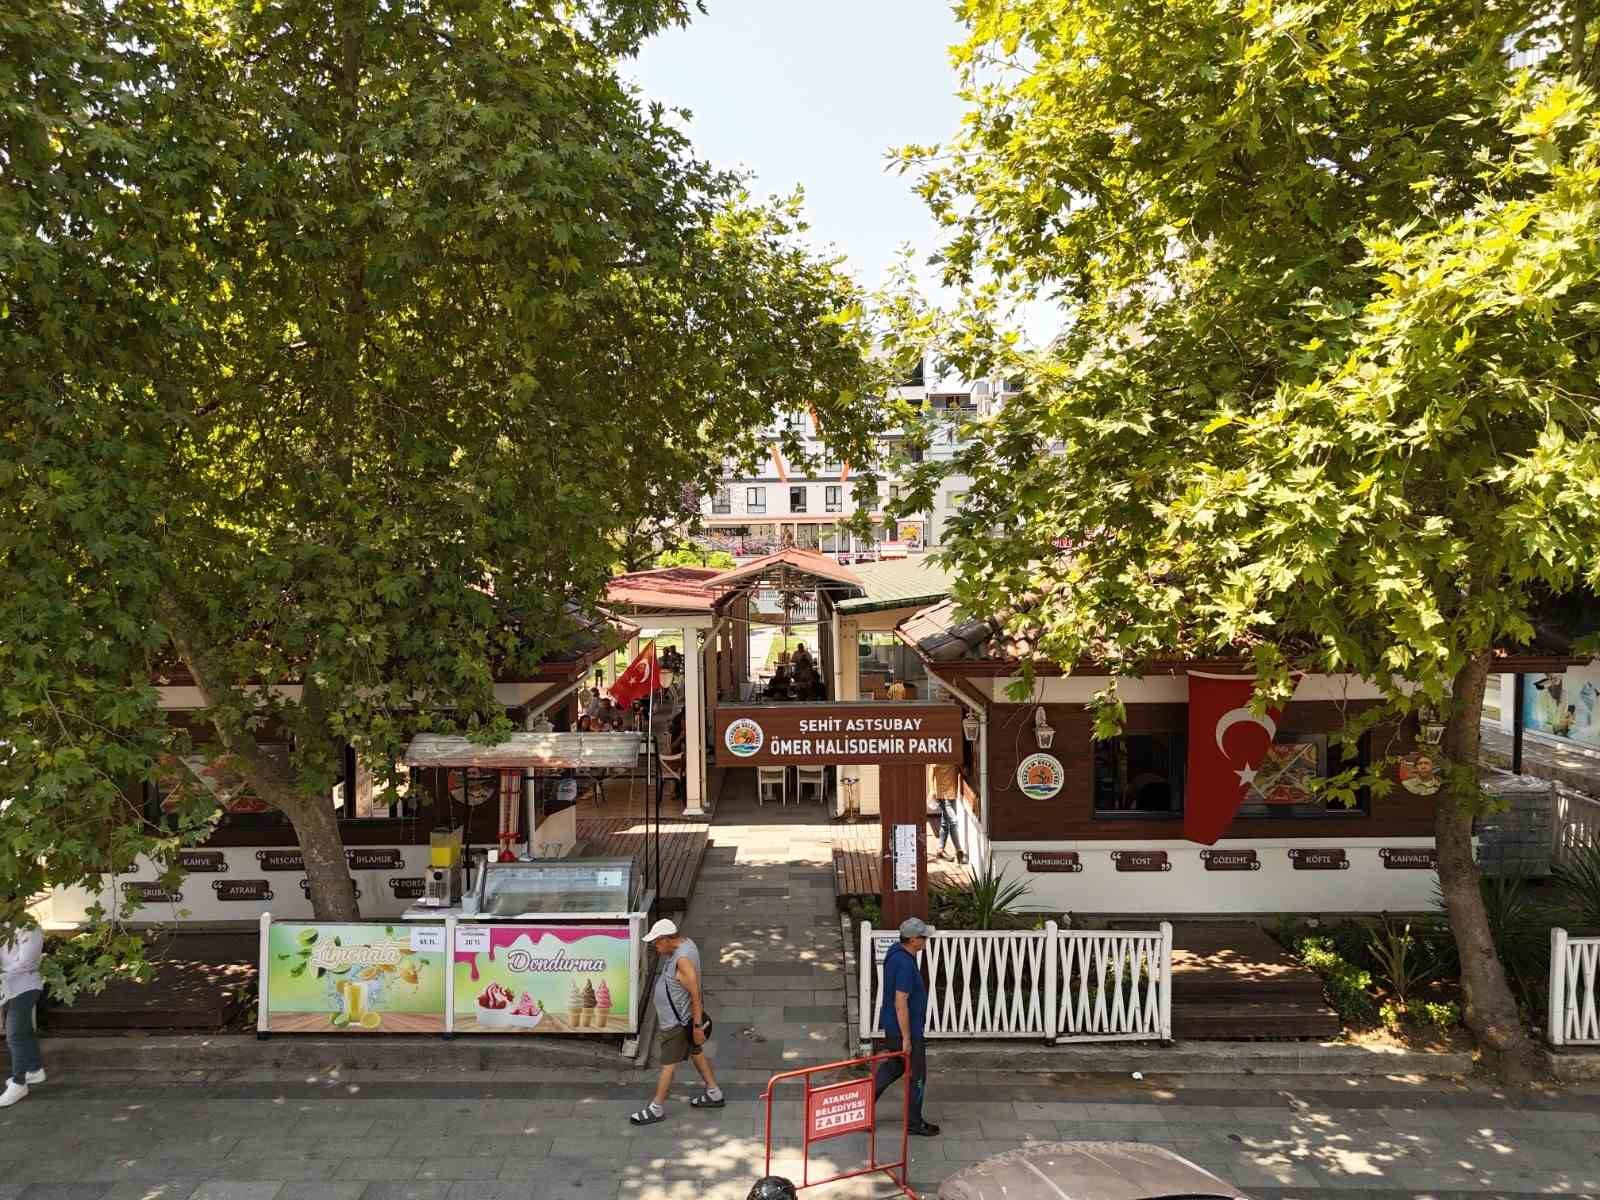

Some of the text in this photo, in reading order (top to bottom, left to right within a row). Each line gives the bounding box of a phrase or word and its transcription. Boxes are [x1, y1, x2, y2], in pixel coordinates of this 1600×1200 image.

[800, 716, 922, 734] ŞEHİT ASTSUBAY
[771, 734, 952, 755] ÖMER HALİSDEMİR PARKI
[1031, 857, 1073, 866] HAMBURGER
[1131, 856, 1152, 865] TOST
[1390, 855, 1430, 864] KAHVALTI
[229, 886, 257, 896] AYRAN
[507, 945, 606, 972] Dondurma
[822, 1091, 859, 1106] ATAKUM
